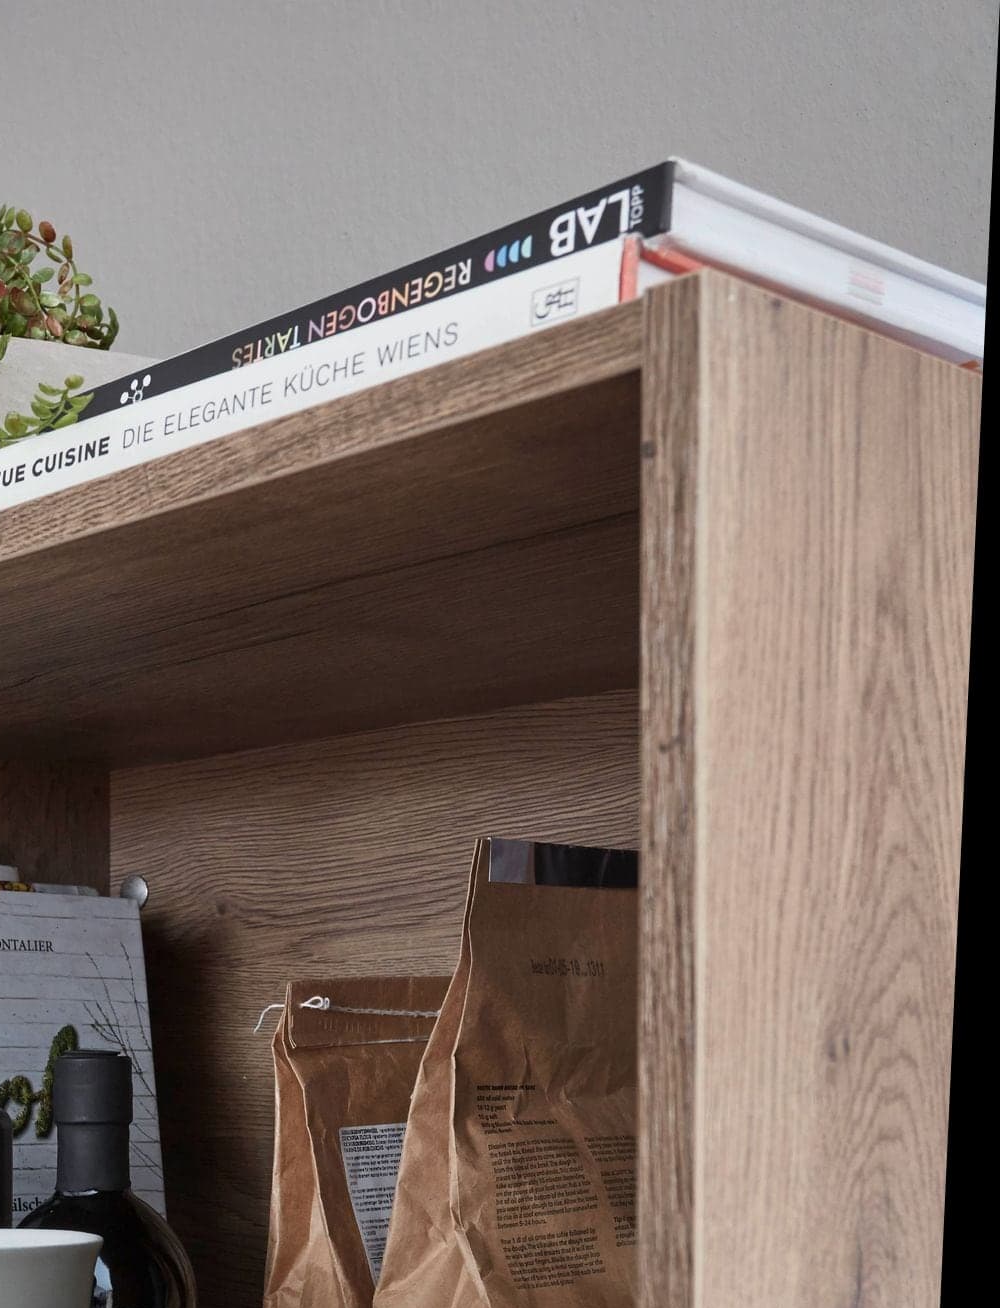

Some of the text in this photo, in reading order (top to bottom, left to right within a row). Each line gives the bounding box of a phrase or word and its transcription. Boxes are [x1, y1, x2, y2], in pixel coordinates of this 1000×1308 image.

[549, 188, 630, 258] LAB
[629, 184, 645, 229] TOPP
[308, 257, 473, 343] REGENBOGEN
[231, 324, 301, 369] TARTES
[31, 436, 111, 478] CUISINE
[122, 420, 155, 450] DIE
[163, 381, 273, 437] ELEGANTE
[283, 351, 366, 398] KÜCHE
[377, 323, 459, 367] WIENS
